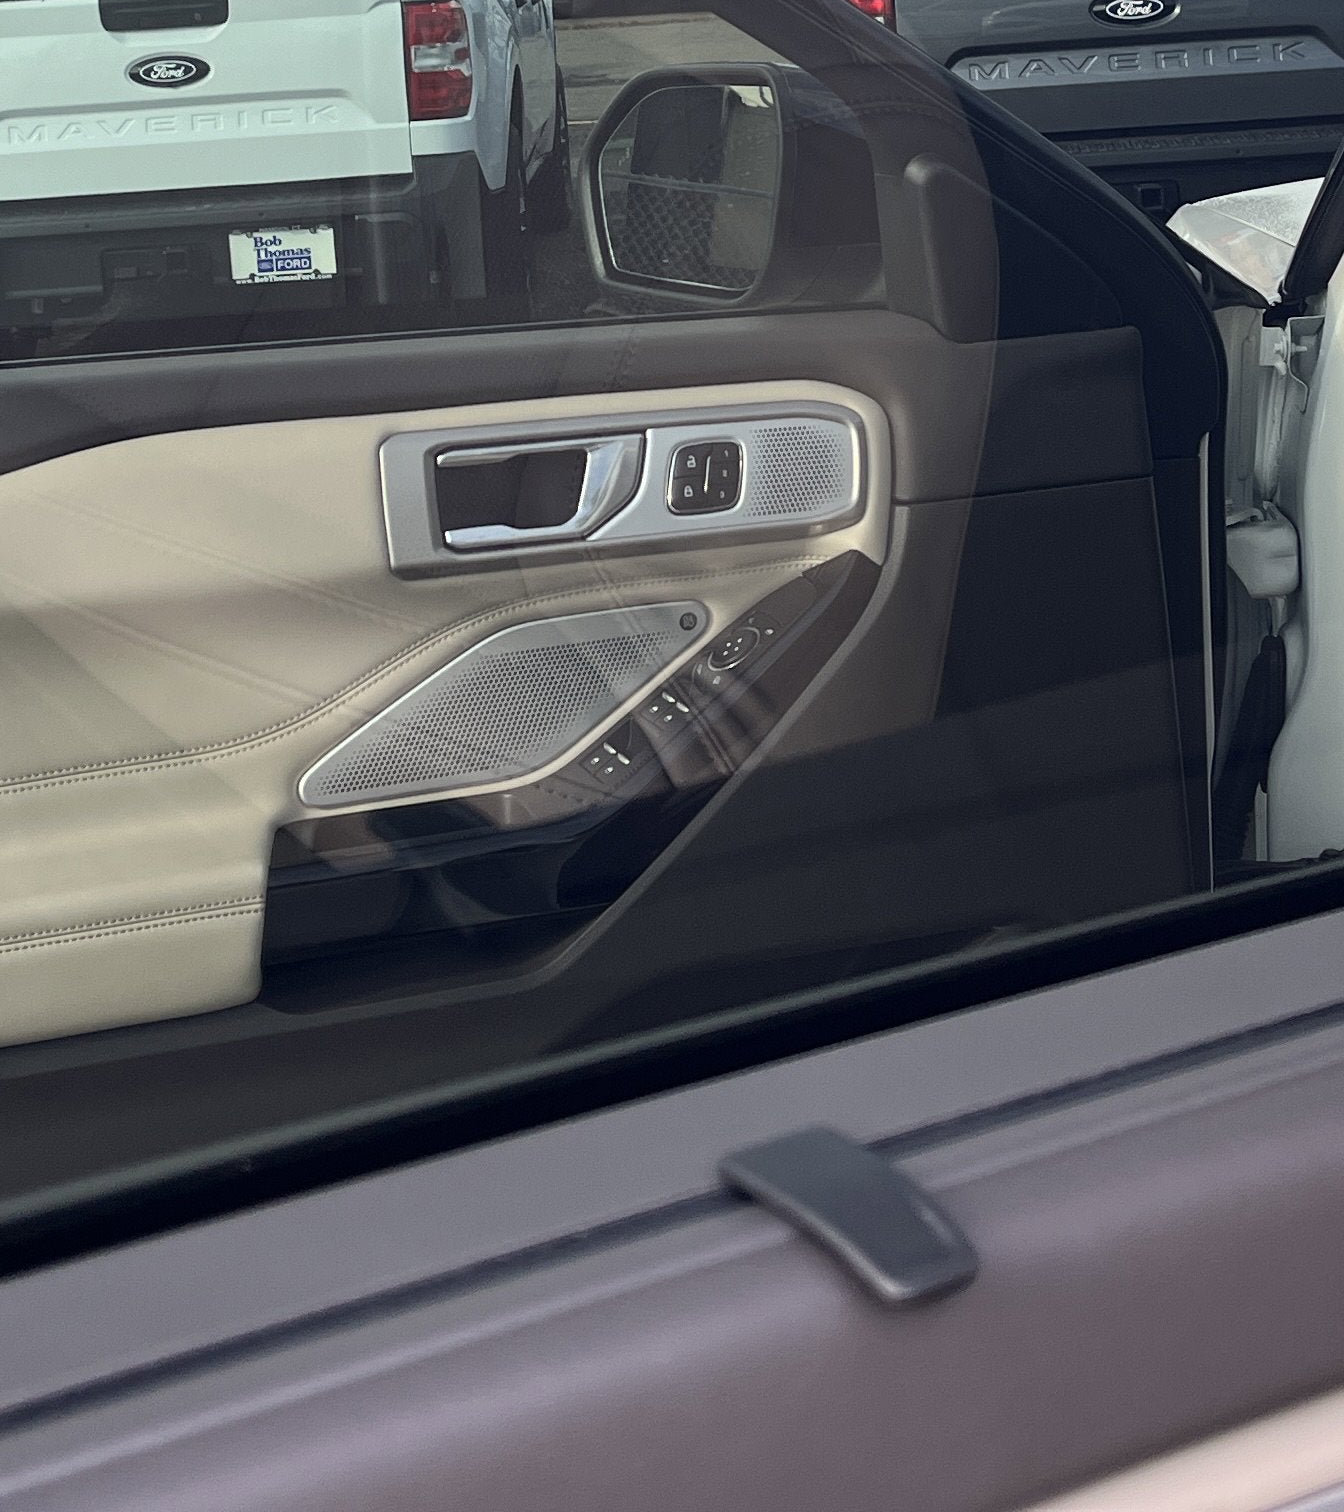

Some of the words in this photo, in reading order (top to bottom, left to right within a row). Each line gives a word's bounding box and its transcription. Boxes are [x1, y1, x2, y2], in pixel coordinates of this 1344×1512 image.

[1117, 0, 1153, 16] Ford
[968, 41, 1306, 81] MAVERICK
[150, 63, 185, 79] Ford
[7, 104, 339, 146] MAVERICK
[254, 235, 282, 248] Bob
[254, 248, 311, 259] Thomas
[277, 258, 310, 270] FORD
